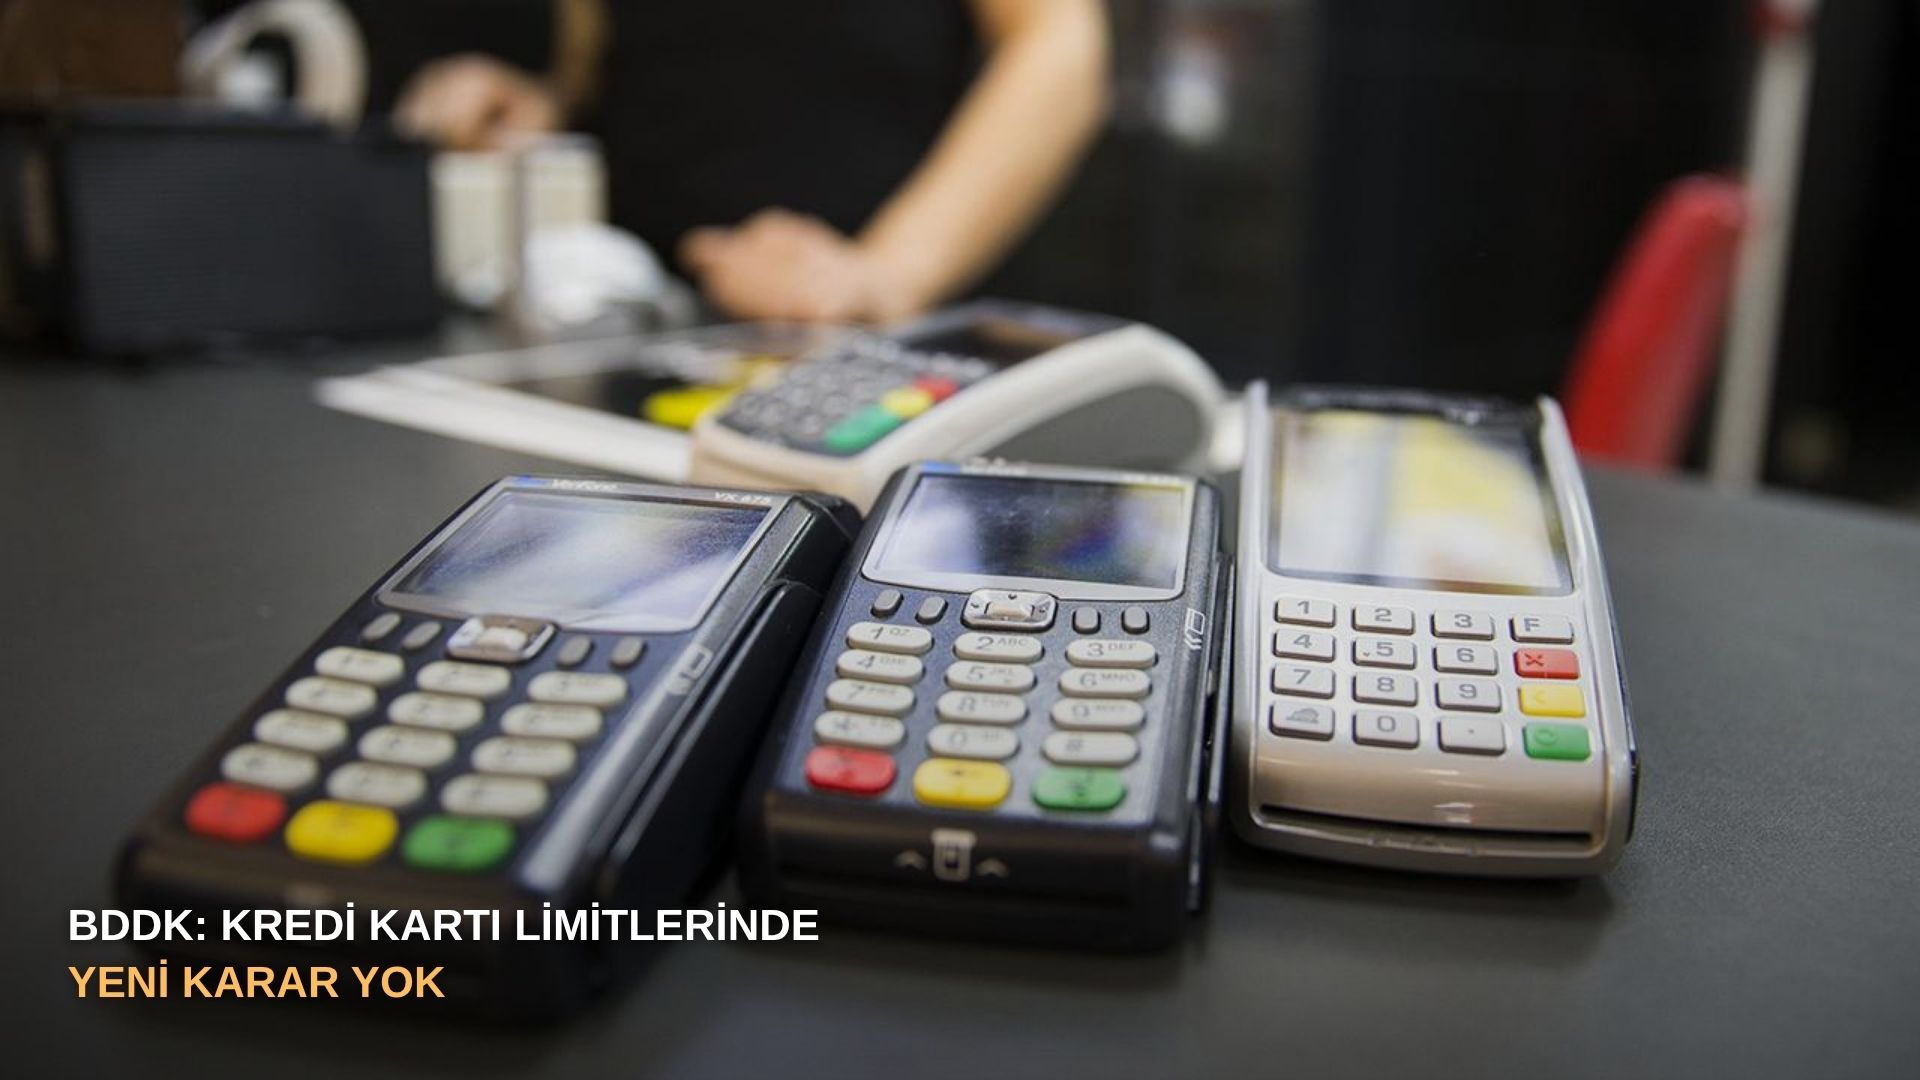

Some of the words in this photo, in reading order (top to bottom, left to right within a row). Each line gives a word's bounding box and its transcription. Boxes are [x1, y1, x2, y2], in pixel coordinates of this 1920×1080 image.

[1297, 600, 1310, 615] 1
[1374, 608, 1392, 623] 2
[1454, 613, 1473, 629] 3
[1523, 617, 1541, 633] F
[870, 626, 884, 640] 1
[975, 635, 994, 650] 2
[998, 637, 1028, 647] ABC
[1293, 634, 1312, 649] 4
[1376, 641, 1394, 657] 5
[1087, 642, 1105, 658] 3
[1457, 647, 1475, 663] 6
[857, 654, 875, 669] 4
[966, 665, 985, 681] 5
[1080, 672, 1098, 688] 6
[1293, 669, 1311, 685] 7
[1376, 677, 1395, 693] 8
[1459, 684, 1477, 699] 9
[1376, 714, 1396, 732] 0
